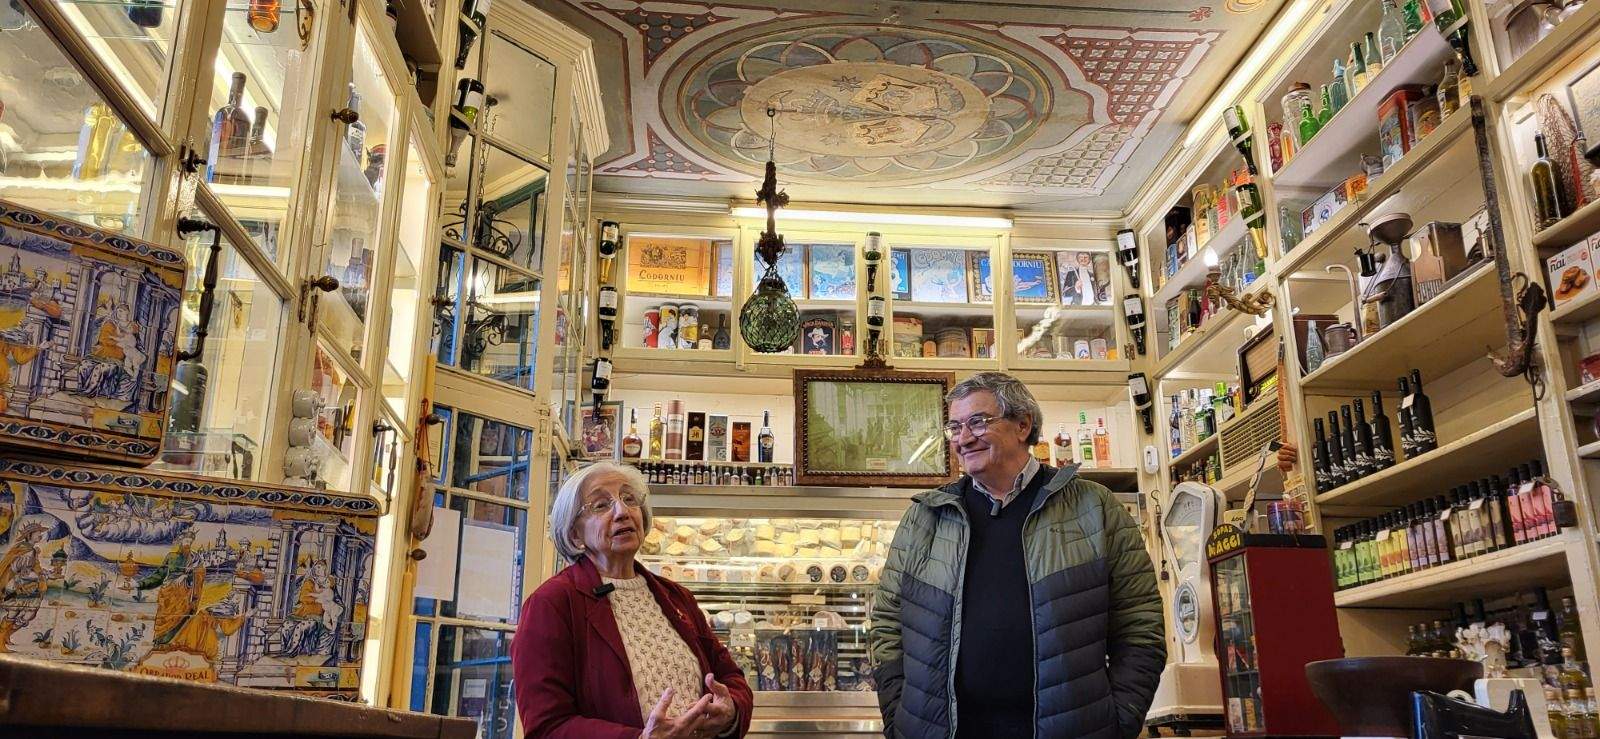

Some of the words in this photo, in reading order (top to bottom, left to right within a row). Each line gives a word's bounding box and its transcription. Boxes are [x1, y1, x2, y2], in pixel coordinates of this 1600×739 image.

[1213, 525, 1233, 540] SOPAS
[1208, 533, 1241, 558] MAGGI
[185, 671, 208, 680] REAL
